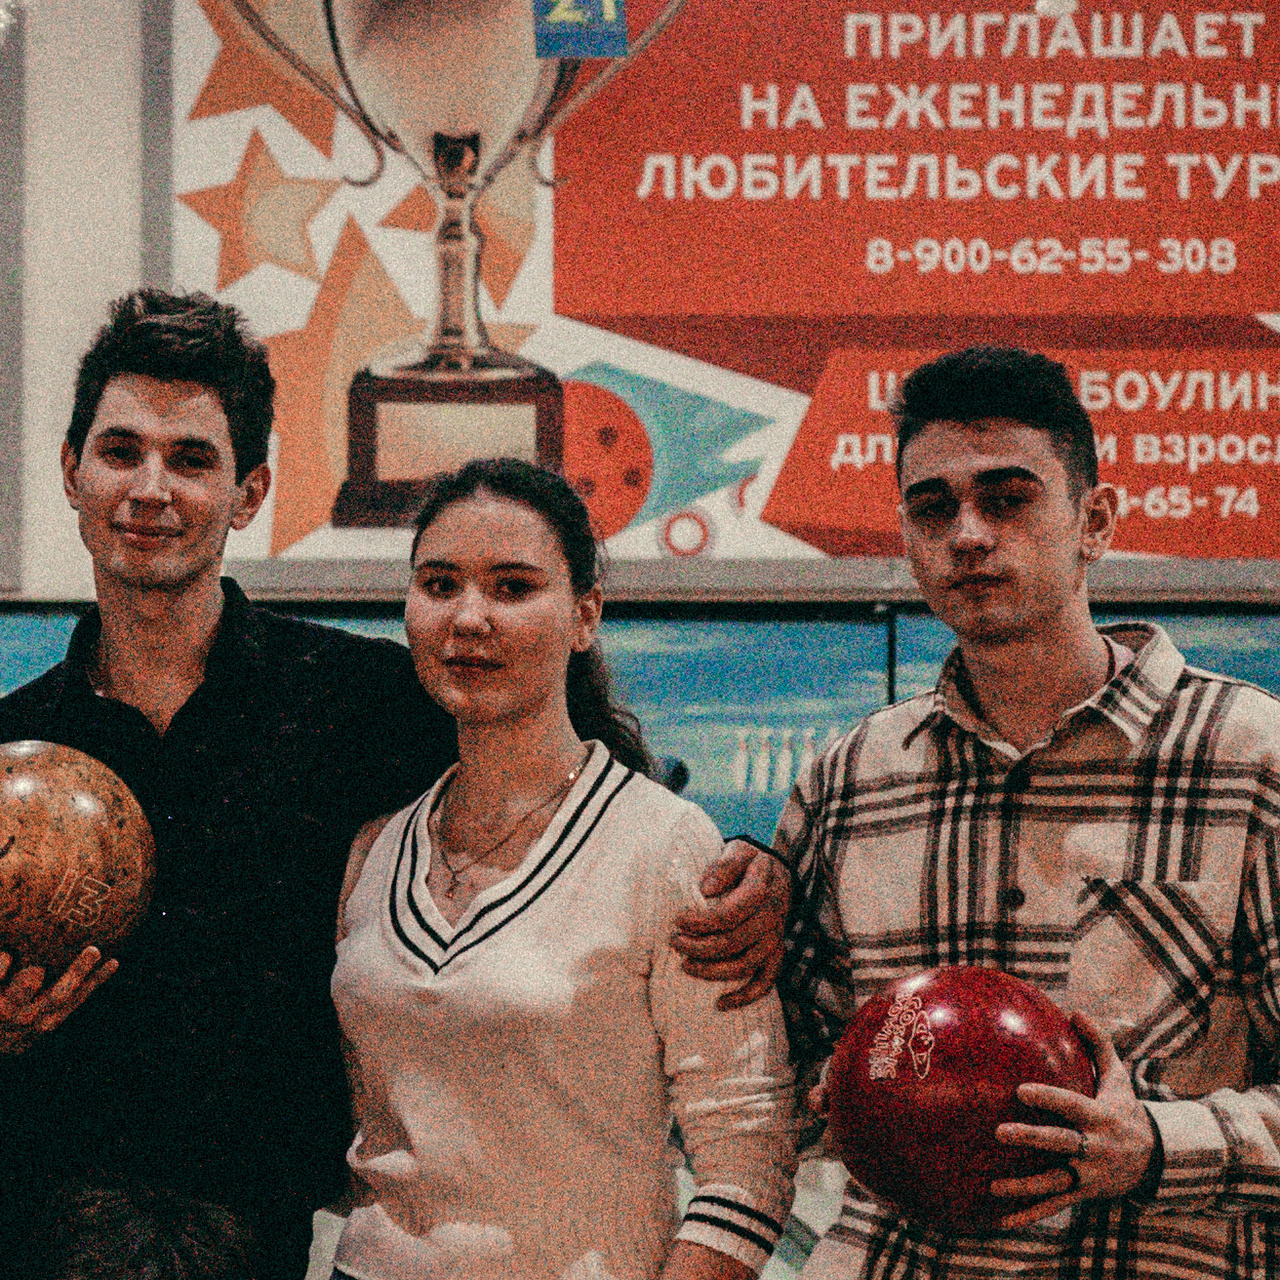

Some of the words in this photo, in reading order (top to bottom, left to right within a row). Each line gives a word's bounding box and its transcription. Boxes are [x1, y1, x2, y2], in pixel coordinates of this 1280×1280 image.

[843, 12, 1266, 59] ПРИГЛАШАЕТ
[740, 82, 825, 130] НА
[845, 82, 1280, 140] ЕЖЕНЕДЕЛЬН
[635, 153, 1148, 201] ЛЮБИТЕЛЬСКИЕ
